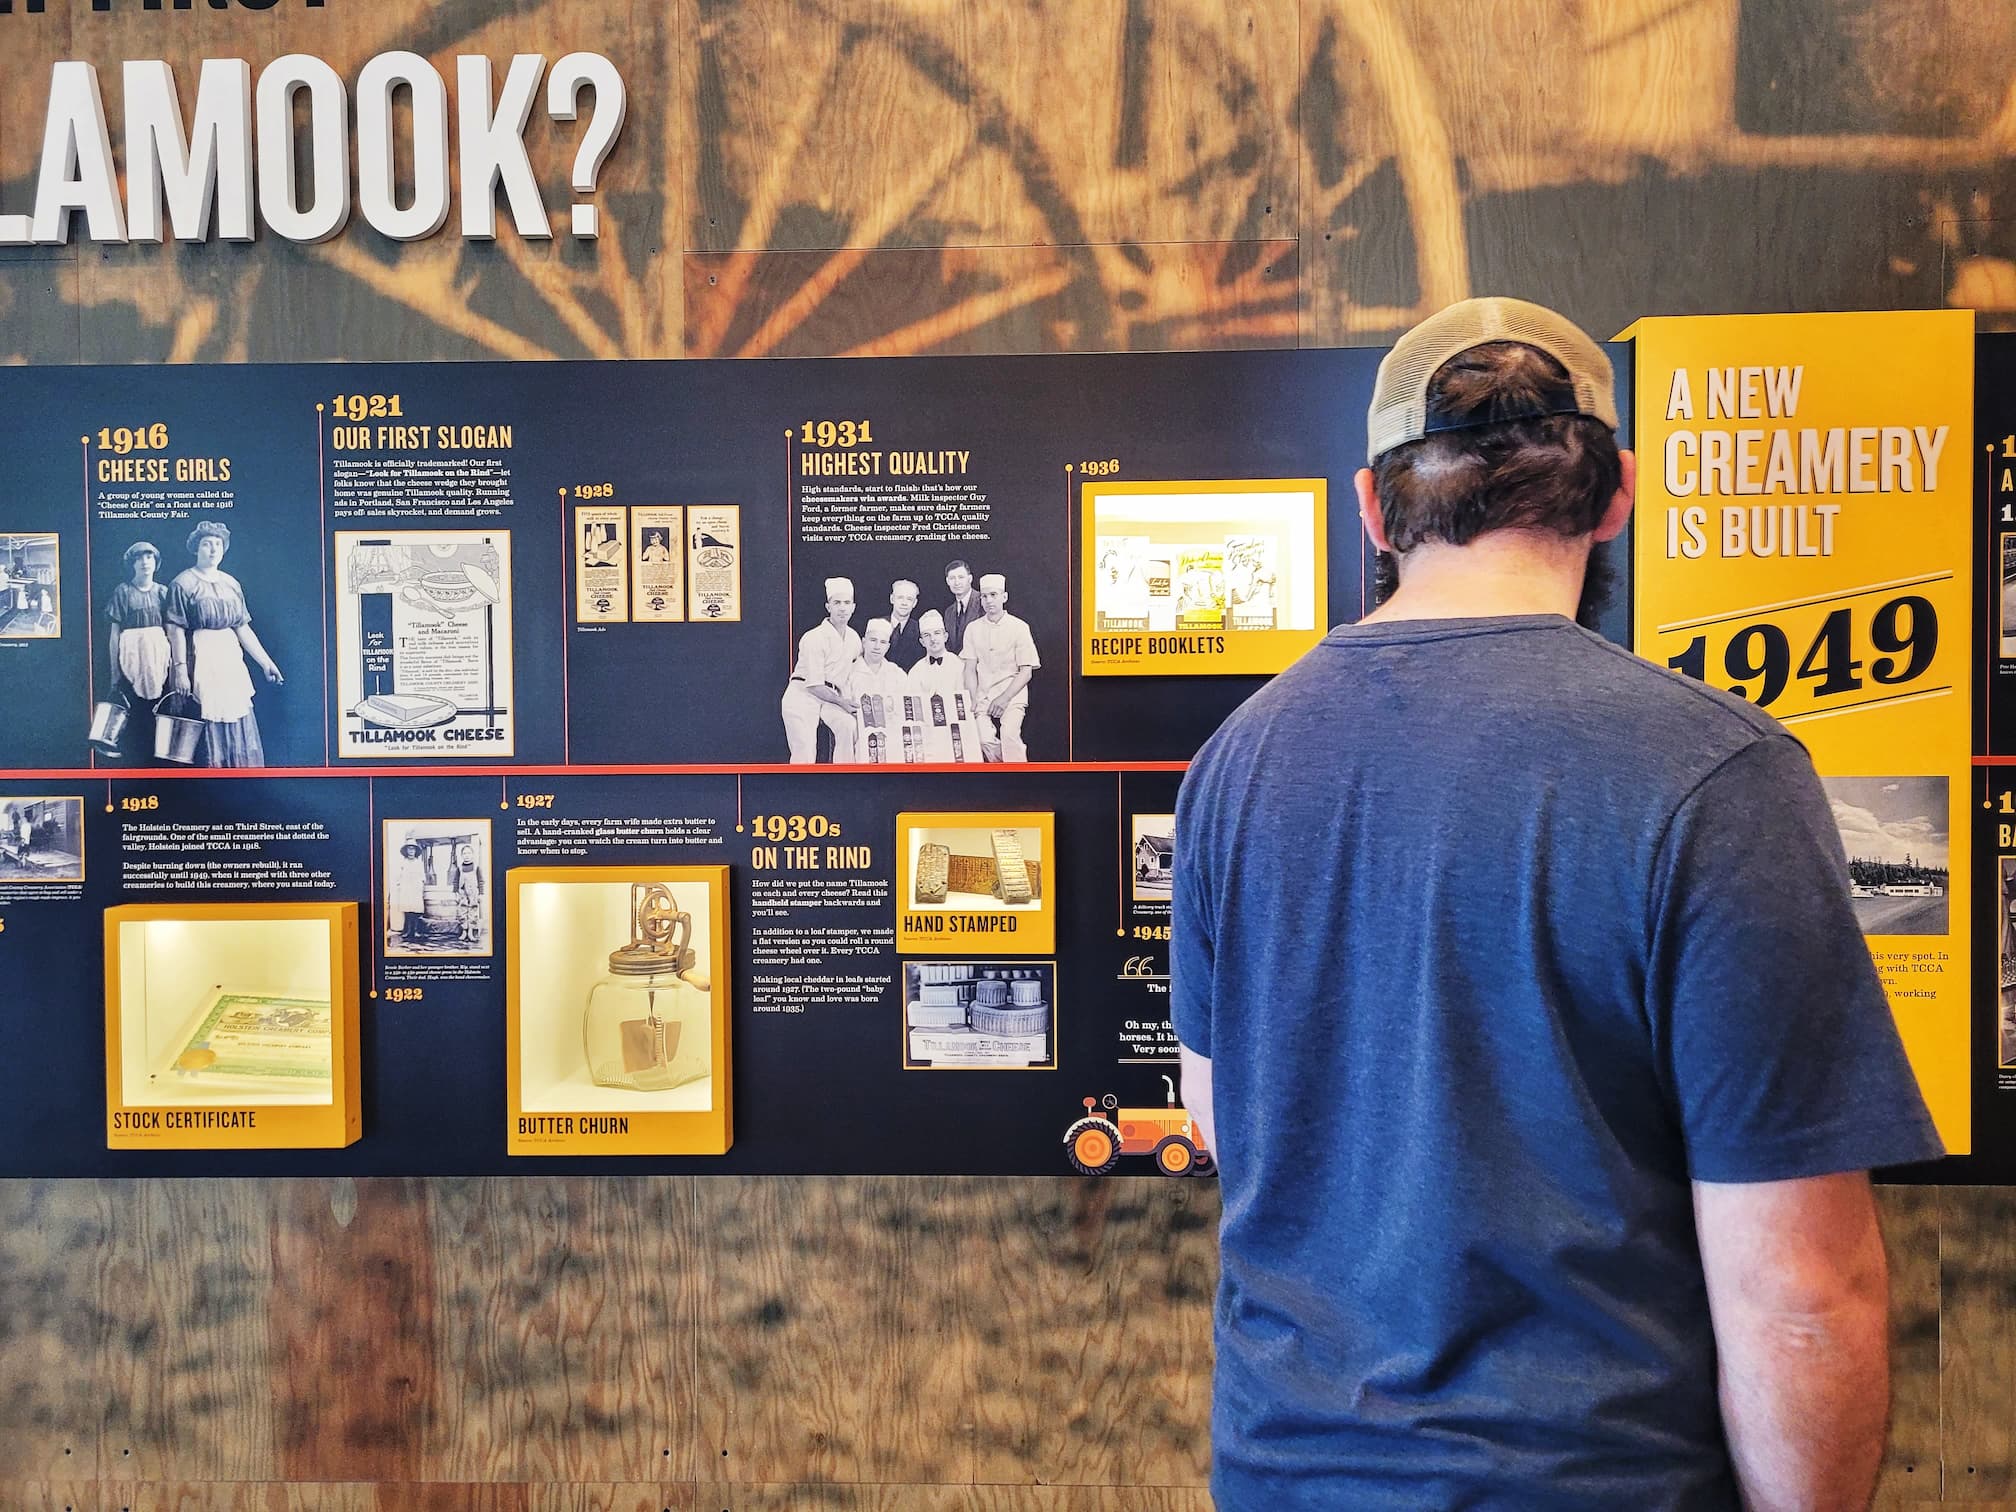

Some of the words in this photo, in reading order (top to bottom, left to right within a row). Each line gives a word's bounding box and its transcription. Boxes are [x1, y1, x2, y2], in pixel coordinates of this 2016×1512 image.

[0, 50, 626, 244] AMOOK?
[1666, 367, 1693, 421] A
[1707, 365, 1804, 419] NEW
[332, 394, 403, 422] 1921
[98, 423, 168, 454] 1916
[333, 426, 371, 450] OUR
[378, 425, 431, 450] FIRST
[438, 425, 512, 449] SLOGAN
[801, 419, 873, 448] 1931
[333, 458, 372, 467] Tillamook
[374, 458, 381, 467] is
[382, 458, 415, 469] officially
[469, 458, 484, 467] Our
[486, 458, 503, 466] first
[802, 452, 882, 476] HIGHEST
[889, 451, 970, 475] QUALITY
[1079, 459, 1120, 475] 1936
[1665, 425, 1949, 498] CREAMERY
[98, 459, 169, 483] CHEESE
[176, 458, 231, 482] GIRLS
[2001, 468, 2014, 492] A
[98, 490, 104, 499] A
[106, 492, 129, 501] group
[131, 490, 139, 499] of
[140, 492, 164, 501] young
[195, 490, 219, 499] called
[221, 490, 234, 499] the
[334, 488, 355, 497] home
[372, 488, 403, 499] genuine
[404, 488, 444, 496] Tillamook
[475, 487, 510, 498] Running
[574, 483, 614, 499] 1928
[801, 484, 821, 495] High
[864, 484, 883, 492] start
[885, 483, 893, 492] to
[921, 483, 943, 492] that's
[944, 483, 961, 492] how
[173, 500, 191, 509] float
[192, 500, 200, 508] at
[201, 500, 214, 508] the
[216, 500, 234, 510] 1916
[98, 510, 138, 518] Tillamook
[140, 510, 168, 520] County
[844, 523, 872, 532] Cheese
[873, 522, 910, 533] inspector
[911, 522, 930, 531] Fred
[932, 522, 981, 530] Christensen
[1667, 506, 1708, 559] IS
[1721, 504, 1842, 558] BUILT
[1091, 637, 1143, 656] RECIPE
[1149, 636, 1225, 654] BOOKLETS
[1668, 595, 1939, 708] 1949
[349, 730, 436, 743] TILLAMOOK
[443, 728, 505, 741] CHEESE
[121, 795, 159, 811] 1918
[516, 794, 555, 809] 1927
[122, 822, 137, 831] The
[139, 822, 171, 831] Holstein
[172, 822, 210, 833] Creamery
[211, 822, 222, 831] sat
[235, 822, 257, 831] Third
[285, 822, 300, 830] east
[302, 822, 310, 830] of
[311, 822, 324, 830] the
[517, 817, 526, 826] In
[527, 817, 539, 826] the
[540, 817, 559, 828] early
[581, 819, 602, 827] every
[603, 816, 622, 825] farm
[623, 816, 640, 825] wife
[641, 816, 662, 825] made
[663, 816, 683, 825] extra
[684, 816, 707, 825] butter
[707, 816, 716, 825] to
[751, 815, 841, 842] 1930s
[148, 841, 180, 850] Holstein
[181, 841, 204, 852] joined
[206, 841, 230, 850] TCCA
[232, 841, 240, 850] in
[752, 847, 777, 870] ON
[784, 846, 820, 869] THE
[826, 846, 871, 869] RIND
[751, 879, 769, 888] How
[771, 878, 784, 887] did
[798, 878, 810, 889] put
[812, 878, 824, 887] the
[848, 878, 889, 887] Tillamook
[903, 916, 943, 933] HAND
[950, 915, 1018, 933] STAMPED
[1133, 926, 1172, 940] 1945
[1869, 952, 1884, 960] his
[1887, 953, 1909, 961] very
[1912, 952, 1935, 961] spot.
[1938, 952, 1949, 960] In
[1887, 964, 1909, 972] with
[1911, 963, 1944, 973] TCCA
[385, 988, 423, 1003] 1922
[1147, 983, 1167, 993] The
[1894, 989, 1937, 999] working
[1125, 1020, 1140, 1029] Oh
[1142, 1022, 1160, 1031] my,
[1161, 1020, 1174, 1029] th
[1119, 1032, 1155, 1042] horses.
[1156, 1032, 1165, 1041] It
[1167, 1032, 1178, 1041] ha
[1132, 1044, 1156, 1055] Very
[114, 1112, 160, 1129] STOCK
[166, 1111, 256, 1128] CERTIFICATE
[518, 1117, 573, 1134] BUTTER
[580, 1117, 628, 1134] CHURN
